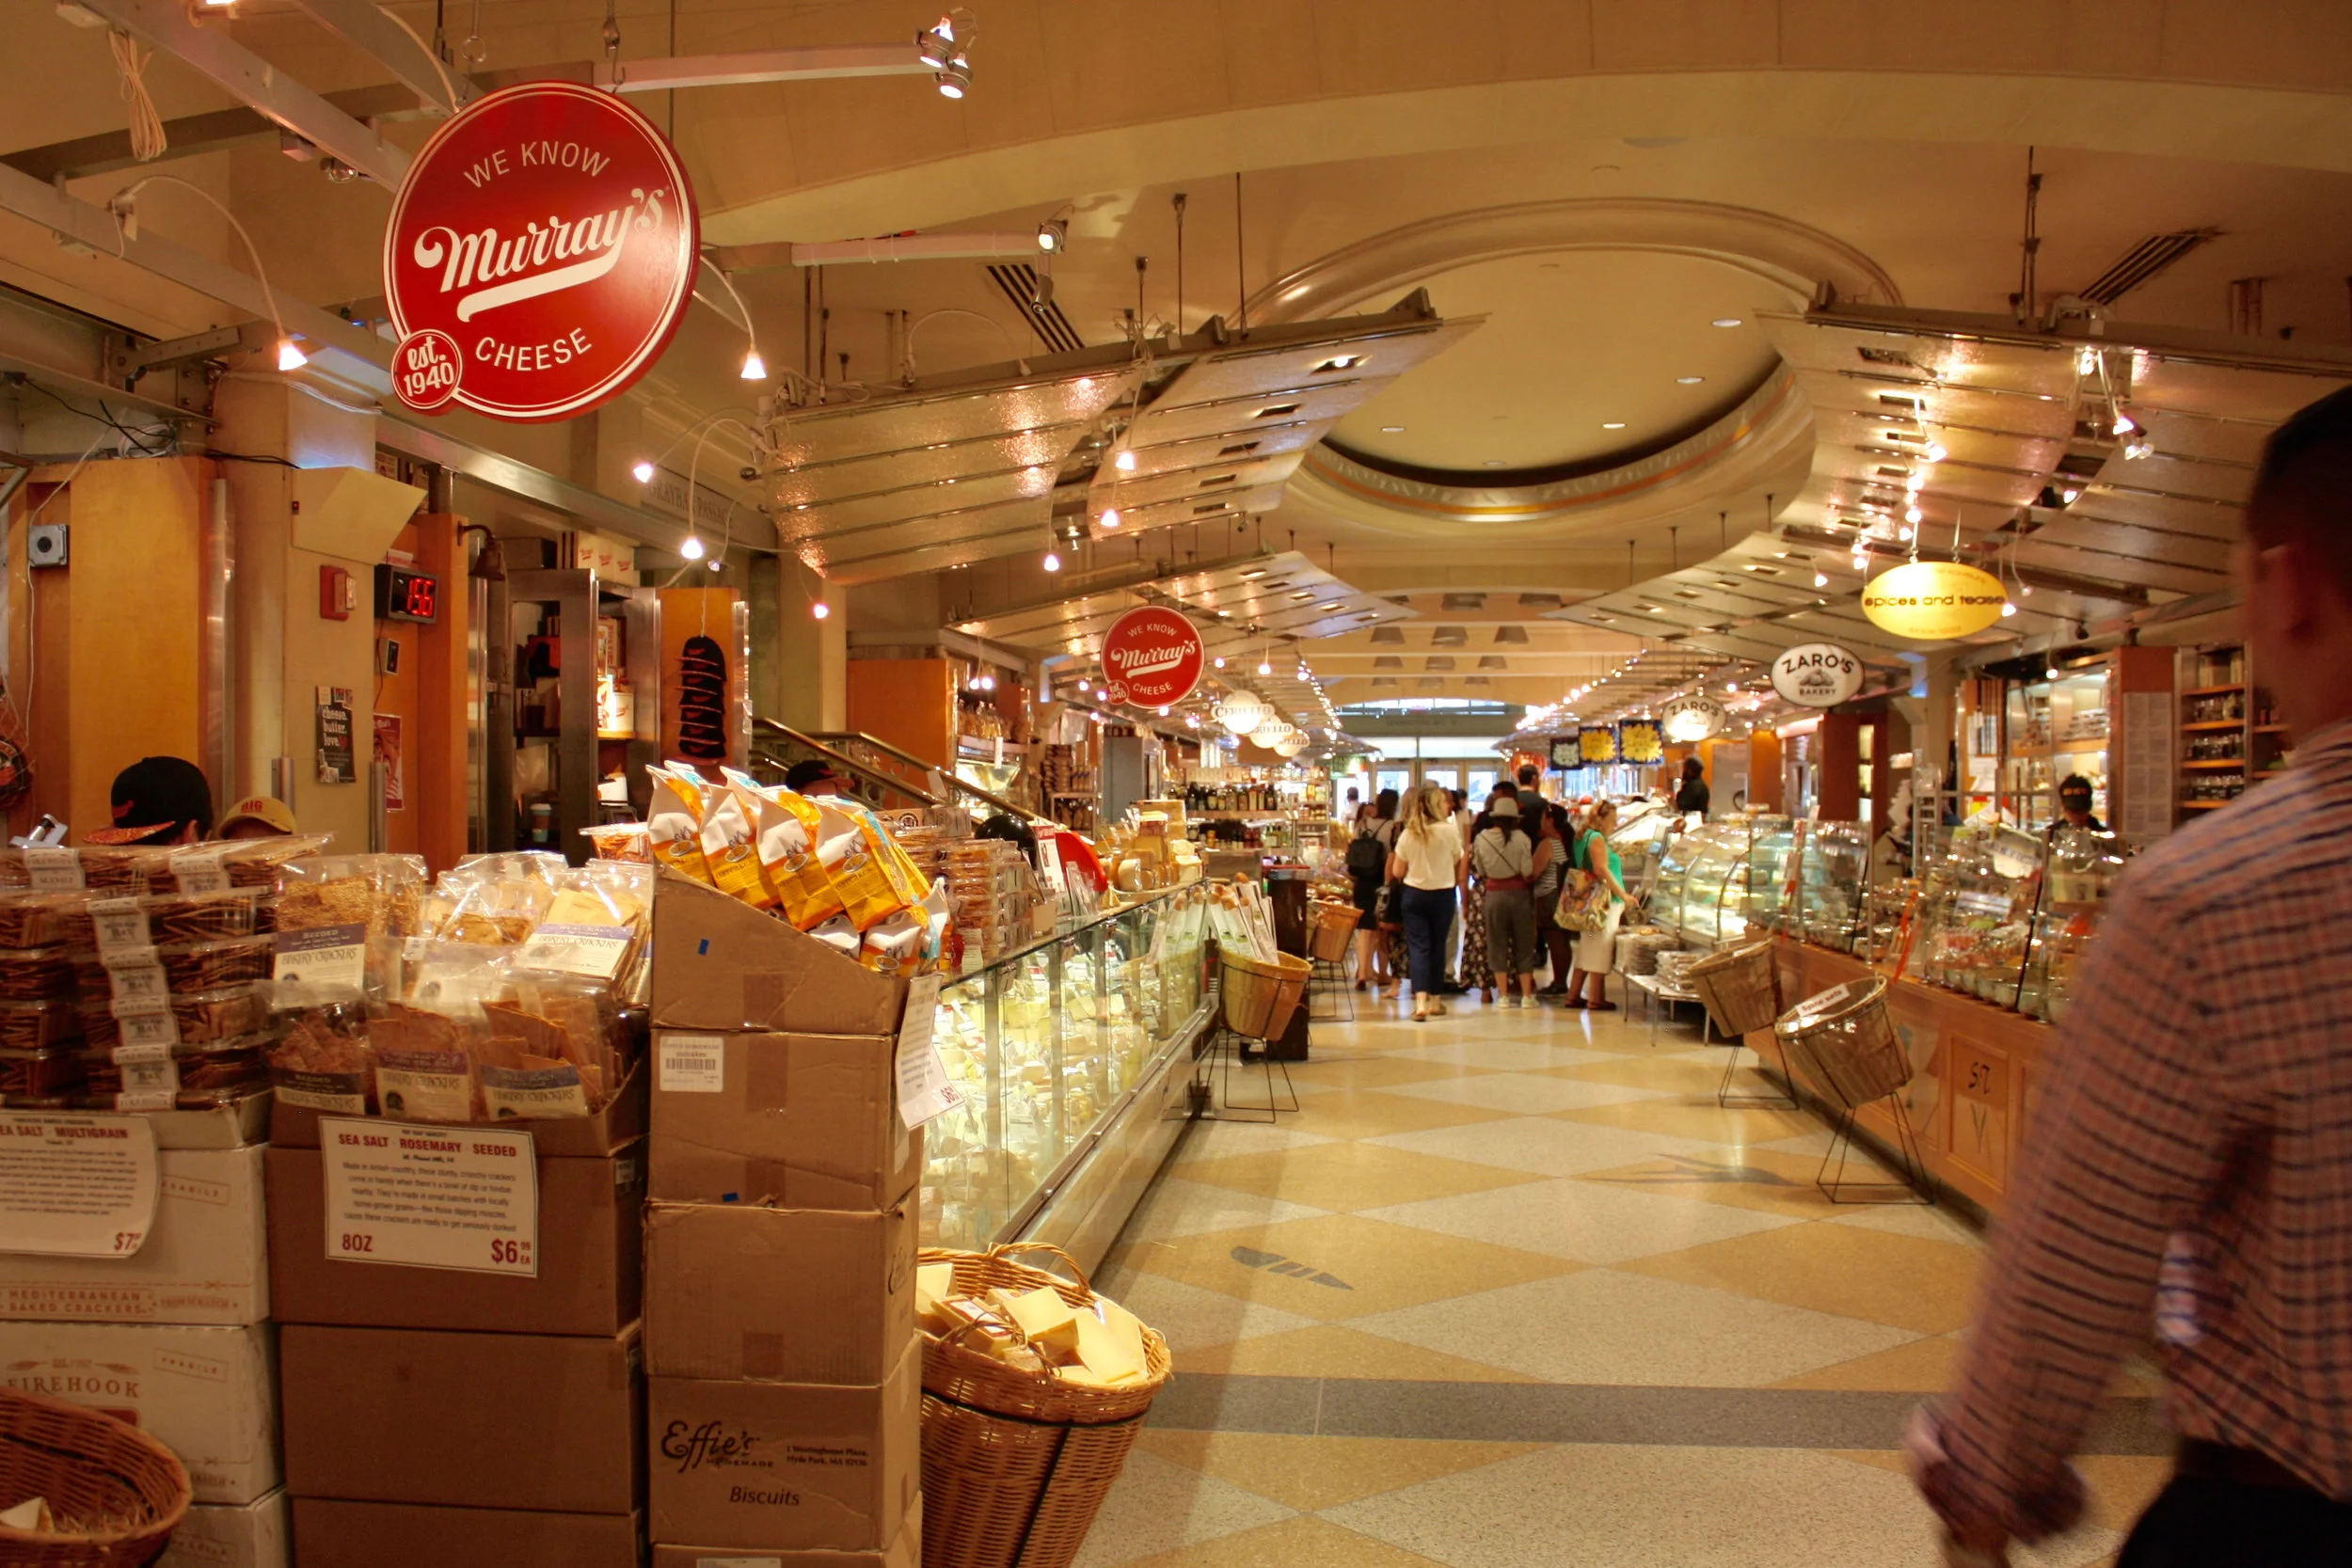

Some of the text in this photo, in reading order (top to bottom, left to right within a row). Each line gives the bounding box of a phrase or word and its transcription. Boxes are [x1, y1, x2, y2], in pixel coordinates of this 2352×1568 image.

[464, 141, 611, 188] WE KNOW
[414, 187, 665, 322] Murray's
[407, 337, 447, 370] est.
[476, 327, 592, 372] CHEESE
[404, 361, 454, 397] 1940
[1923, 594, 1954, 606] and
[1960, 594, 2006, 606] tease
[1127, 623, 1177, 639] WE KNOW
[1111, 640, 1197, 678] Murray's
[1781, 653, 1854, 674] ZARO'S
[1133, 682, 1172, 696] CHEESE
[1799, 687, 1836, 697] BAKERY
[1670, 700, 1721, 717] ZARO'S
[17, 1126, 43, 1136] SALT
[55, 1127, 129, 1139] MULTIGRAIN
[339, 1133, 516, 1157] SEA SALT ROSEMARY SEEDED
[491, 1238, 517, 1264] $6
[8, 1289, 140, 1302] MEDITERRANEAN
[9, 1302, 141, 1315] BAKED CRACKERS
[7, 1375, 140, 1399] FIREHOOK
[660, 1419, 754, 1474] Effie's
[729, 1485, 800, 1507] Biscuits
